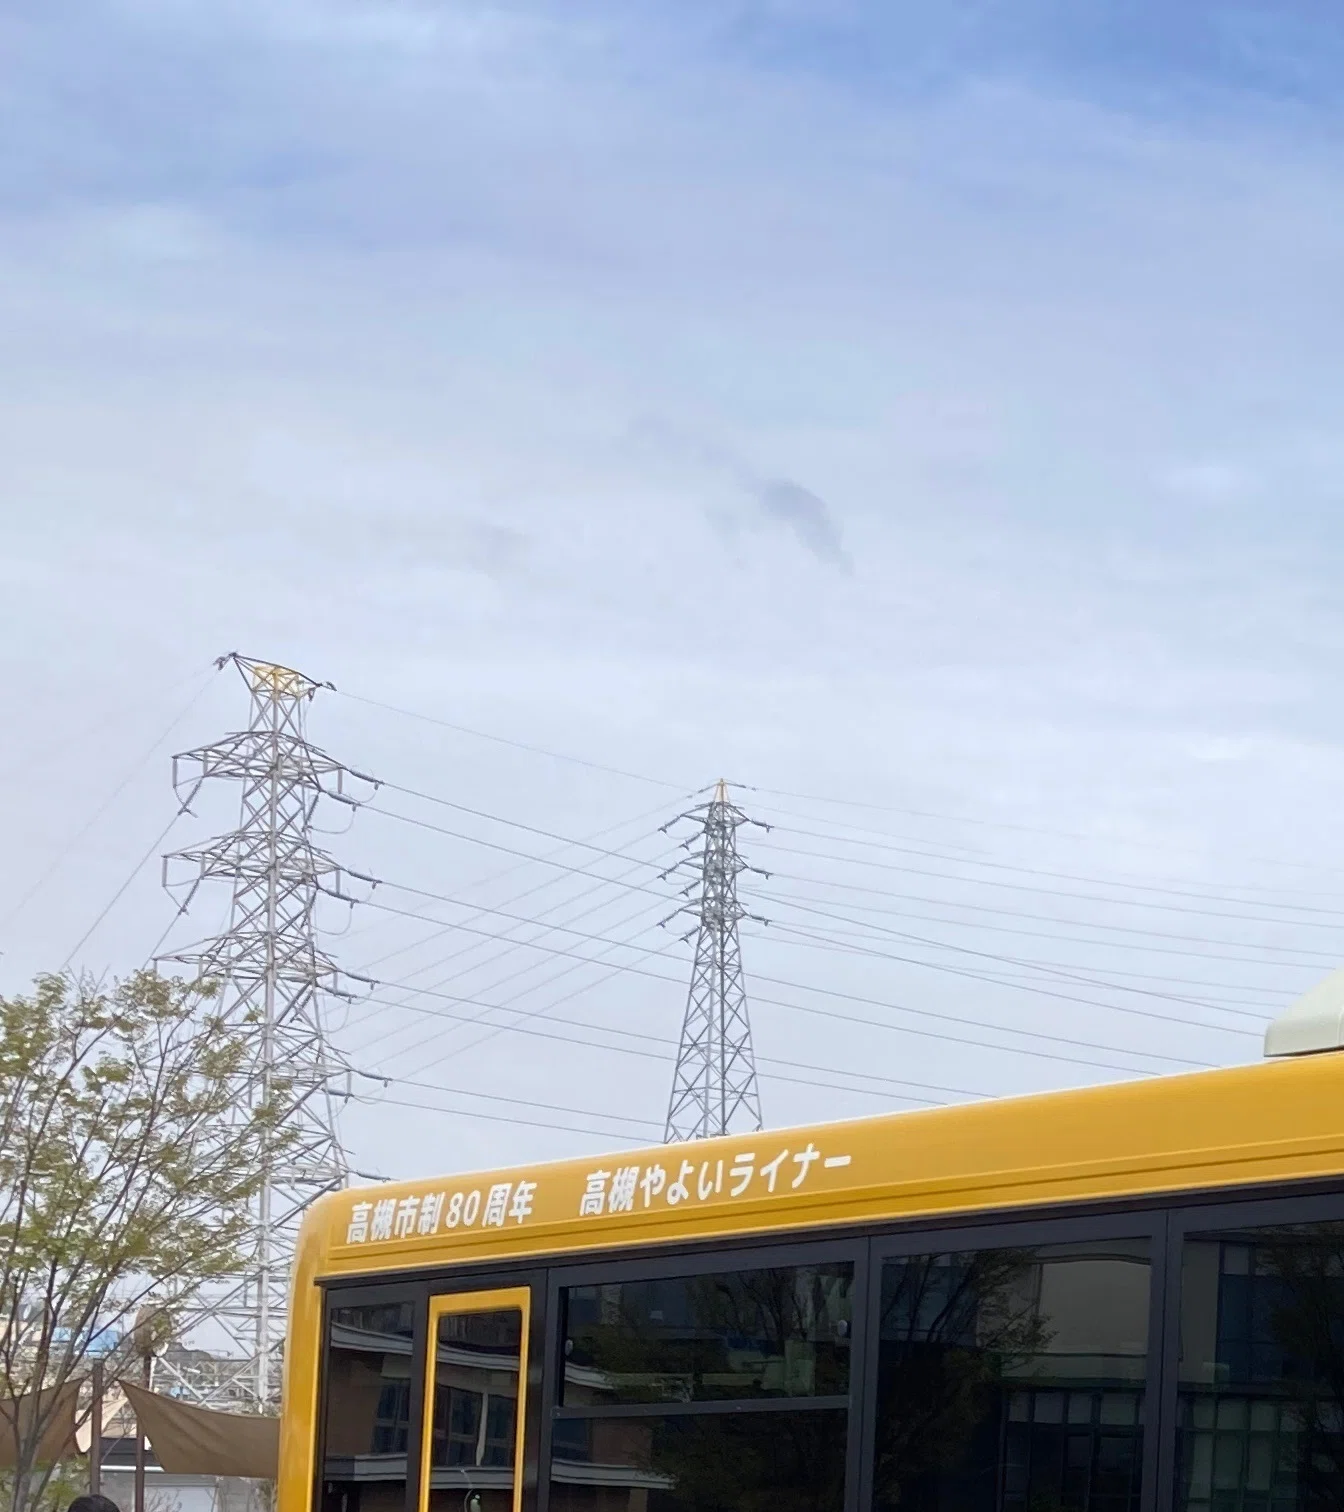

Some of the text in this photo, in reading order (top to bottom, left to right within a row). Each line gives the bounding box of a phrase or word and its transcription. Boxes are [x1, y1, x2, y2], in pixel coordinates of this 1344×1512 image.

[579, 1143, 852, 1217] 高槻やよいライナー
